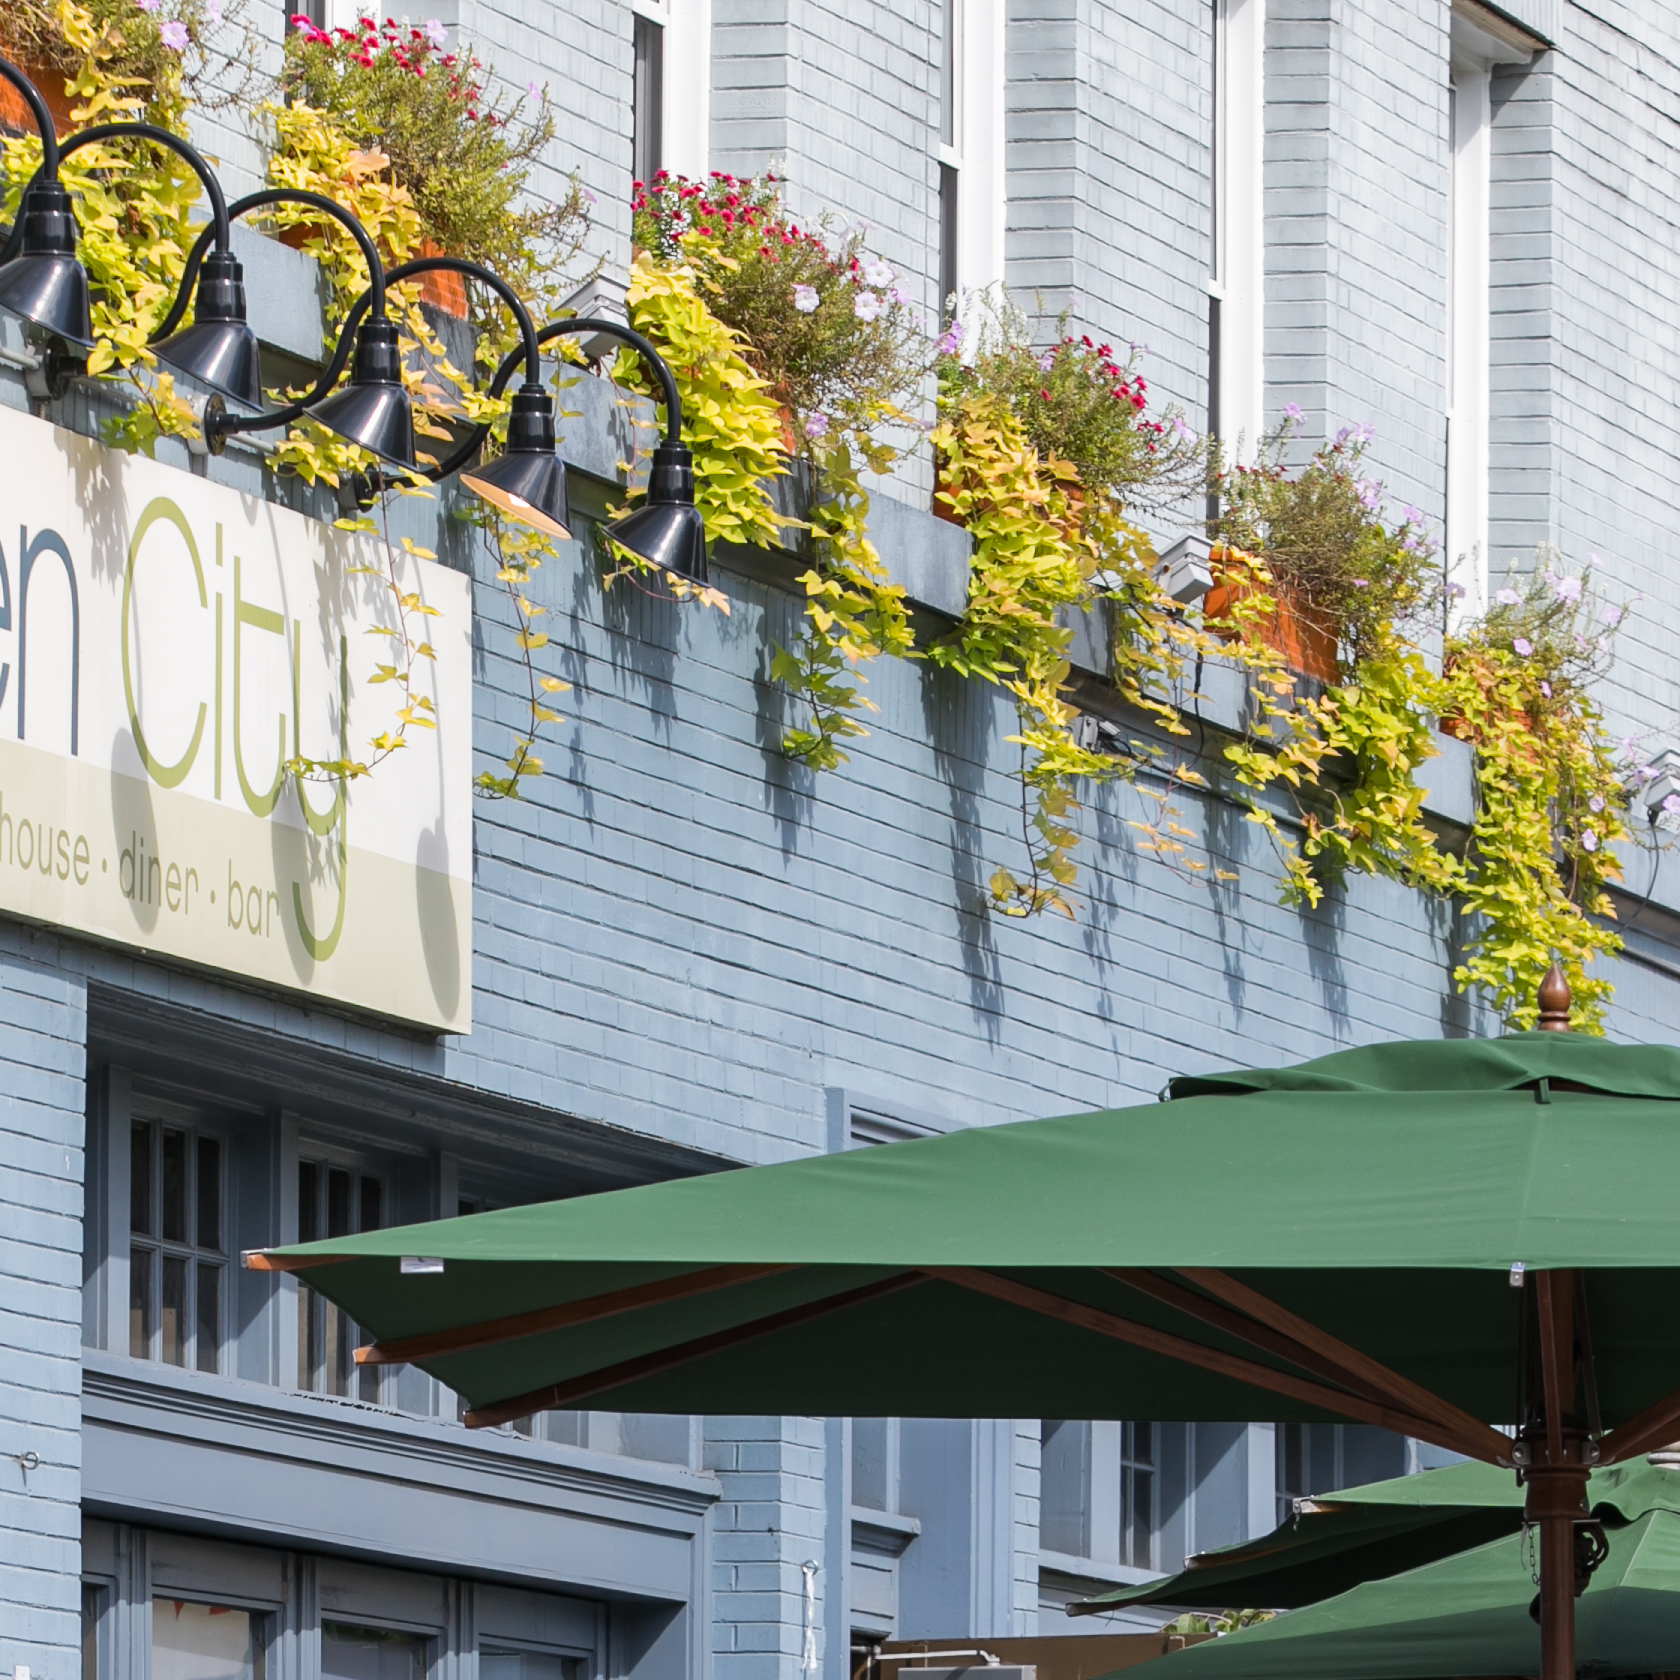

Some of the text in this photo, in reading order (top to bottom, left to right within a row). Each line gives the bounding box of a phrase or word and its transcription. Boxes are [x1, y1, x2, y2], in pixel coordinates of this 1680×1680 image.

[121, 496, 348, 962] City
[119, 830, 199, 915] diner
[227, 859, 280, 938] bar
